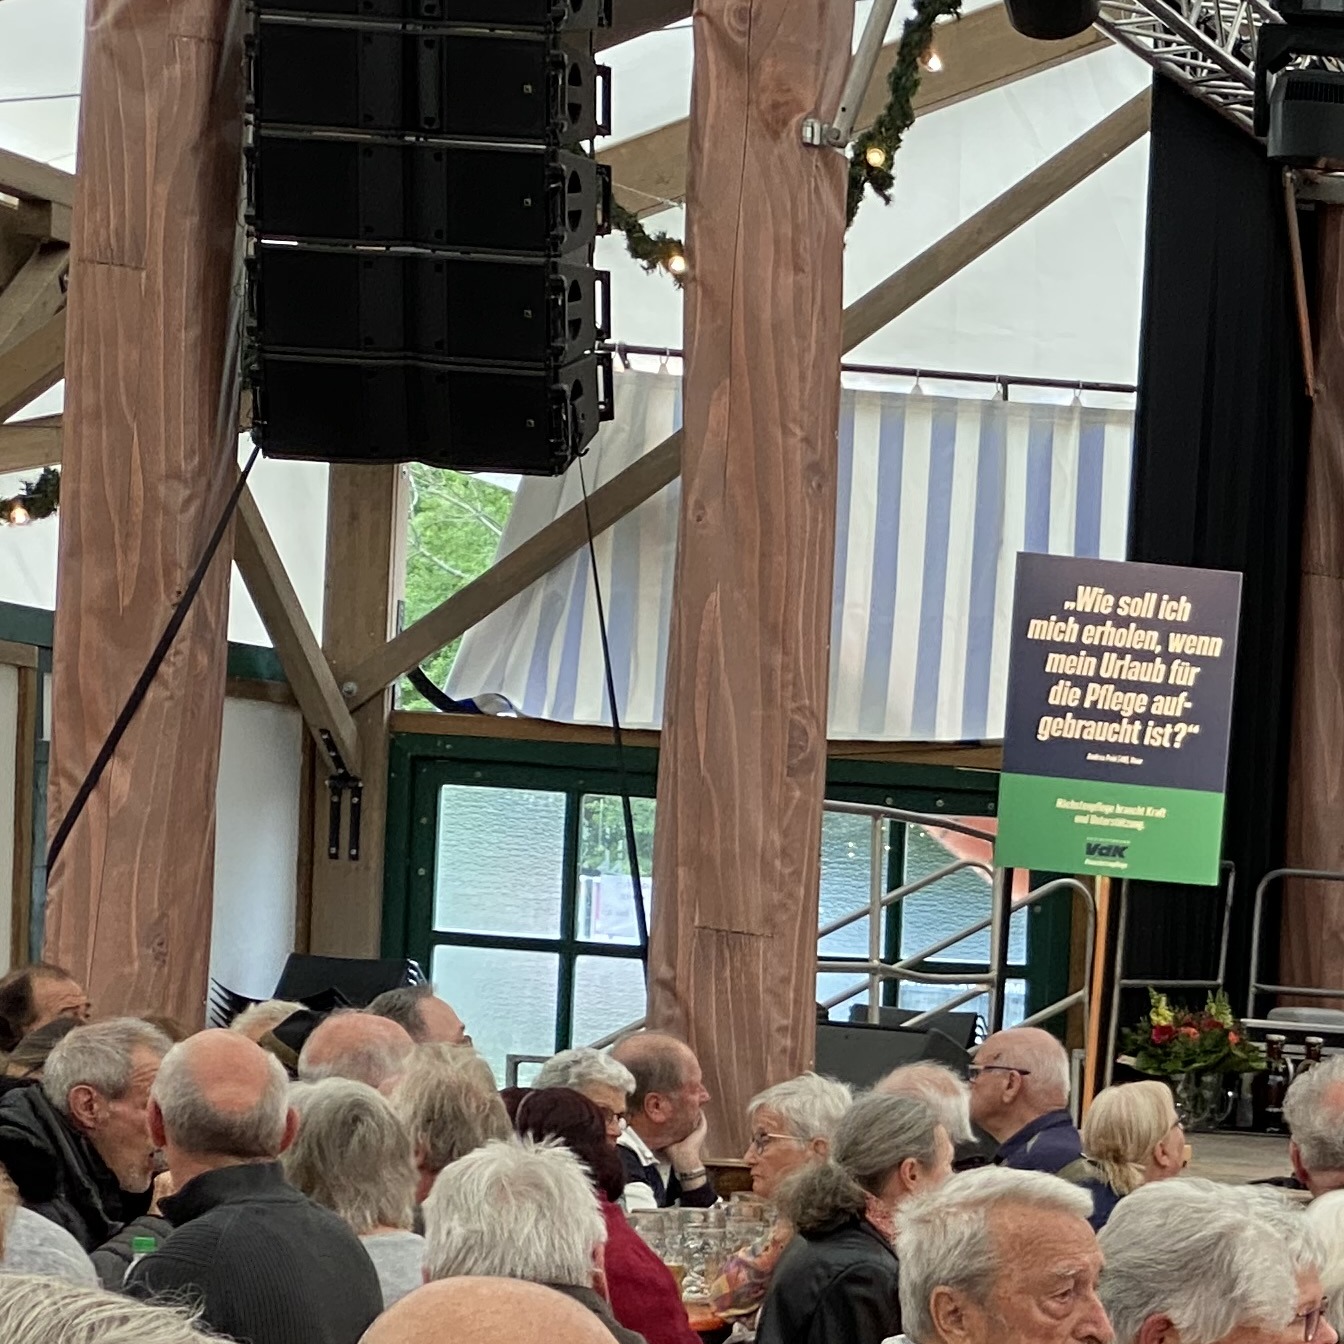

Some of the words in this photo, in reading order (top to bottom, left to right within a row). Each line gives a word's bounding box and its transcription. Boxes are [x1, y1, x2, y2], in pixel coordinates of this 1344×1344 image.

[1064, 585, 1114, 614] „Wie
[1117, 592, 1157, 618] soll
[1158, 595, 1192, 622] ich
[1027, 616, 1079, 643] mich
[1082, 620, 1161, 653] erholen,
[1168, 632, 1223, 657] wenn
[1045, 651, 1097, 676] mein
[1100, 652, 1166, 683] Urlaub
[1169, 659, 1200, 686] für
[1049, 679, 1081, 706] die
[1084, 683, 1148, 716] Pflege
[1151, 692, 1192, 717] auf-
[1037, 713, 1141, 745] gebraucht
[1144, 721, 1199, 748] ist?“
